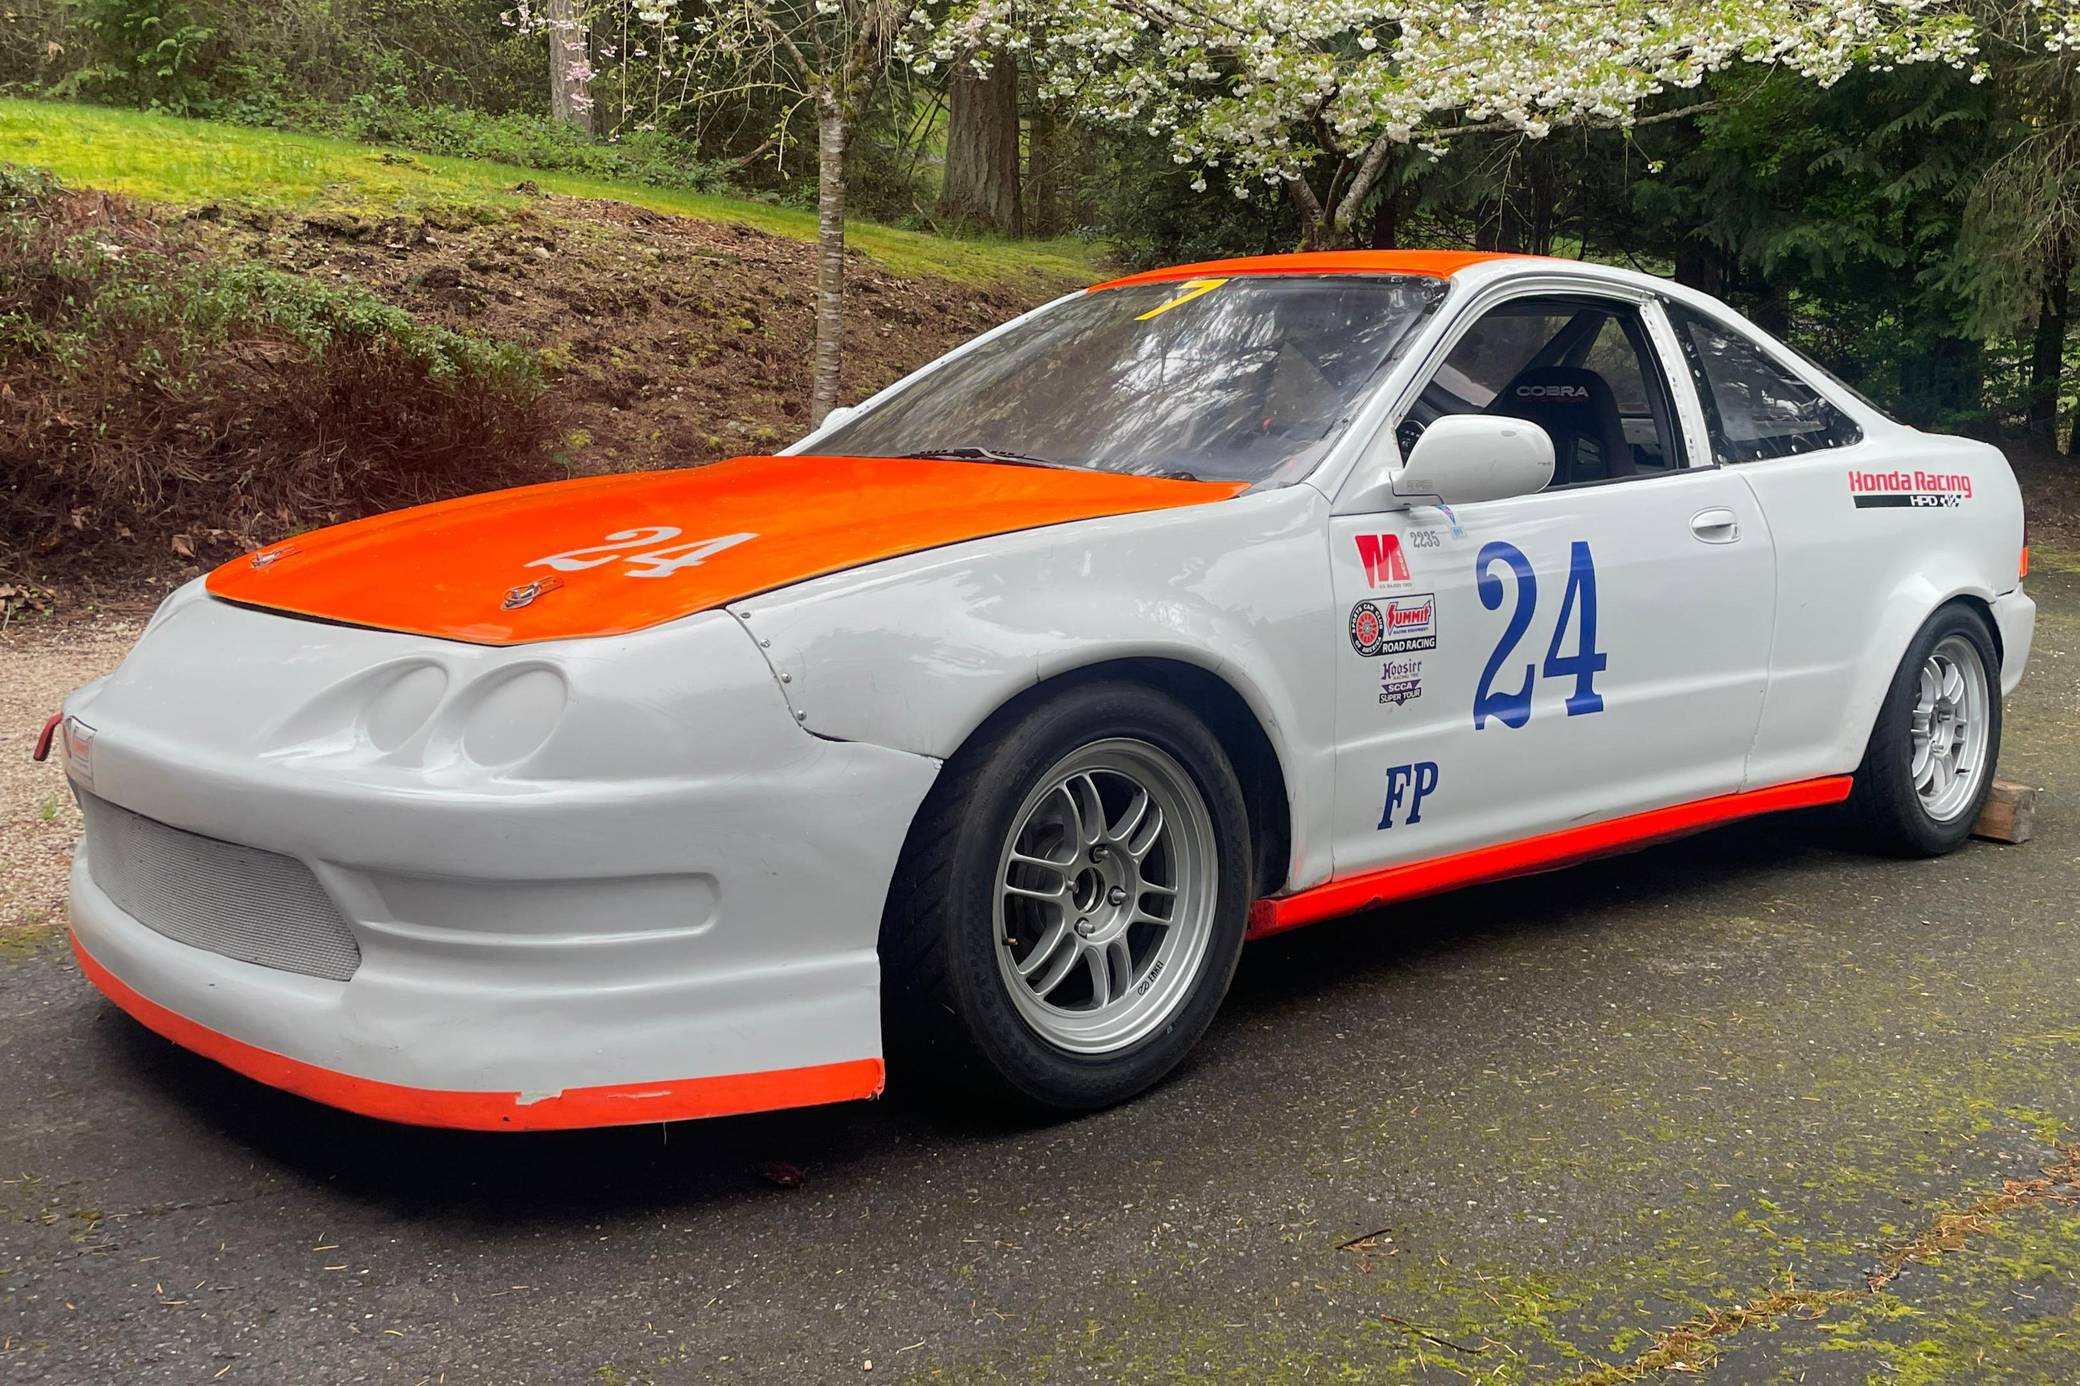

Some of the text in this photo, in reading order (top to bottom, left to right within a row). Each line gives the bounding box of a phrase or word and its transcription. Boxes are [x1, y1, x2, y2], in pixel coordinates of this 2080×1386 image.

[1134, 278, 1229, 320] 7
[1516, 386, 1589, 398] COBRA
[1848, 471, 1972, 498] Honda Racing
[1910, 496, 1938, 507] HPD
[1410, 530, 1440, 548] 2235
[524, 526, 760, 577] 24
[1363, 603, 1374, 611] CAR
[1374, 610, 1383, 629] CLUB
[1382, 637, 1435, 653] ROAD RACING
[1473, 541, 1607, 730] 24
[1381, 658, 1422, 680] Hoosier
[1380, 688, 1420, 703] SUPER TOUR
[1388, 681, 1413, 692] SCCA
[1377, 761, 1438, 830] FP
